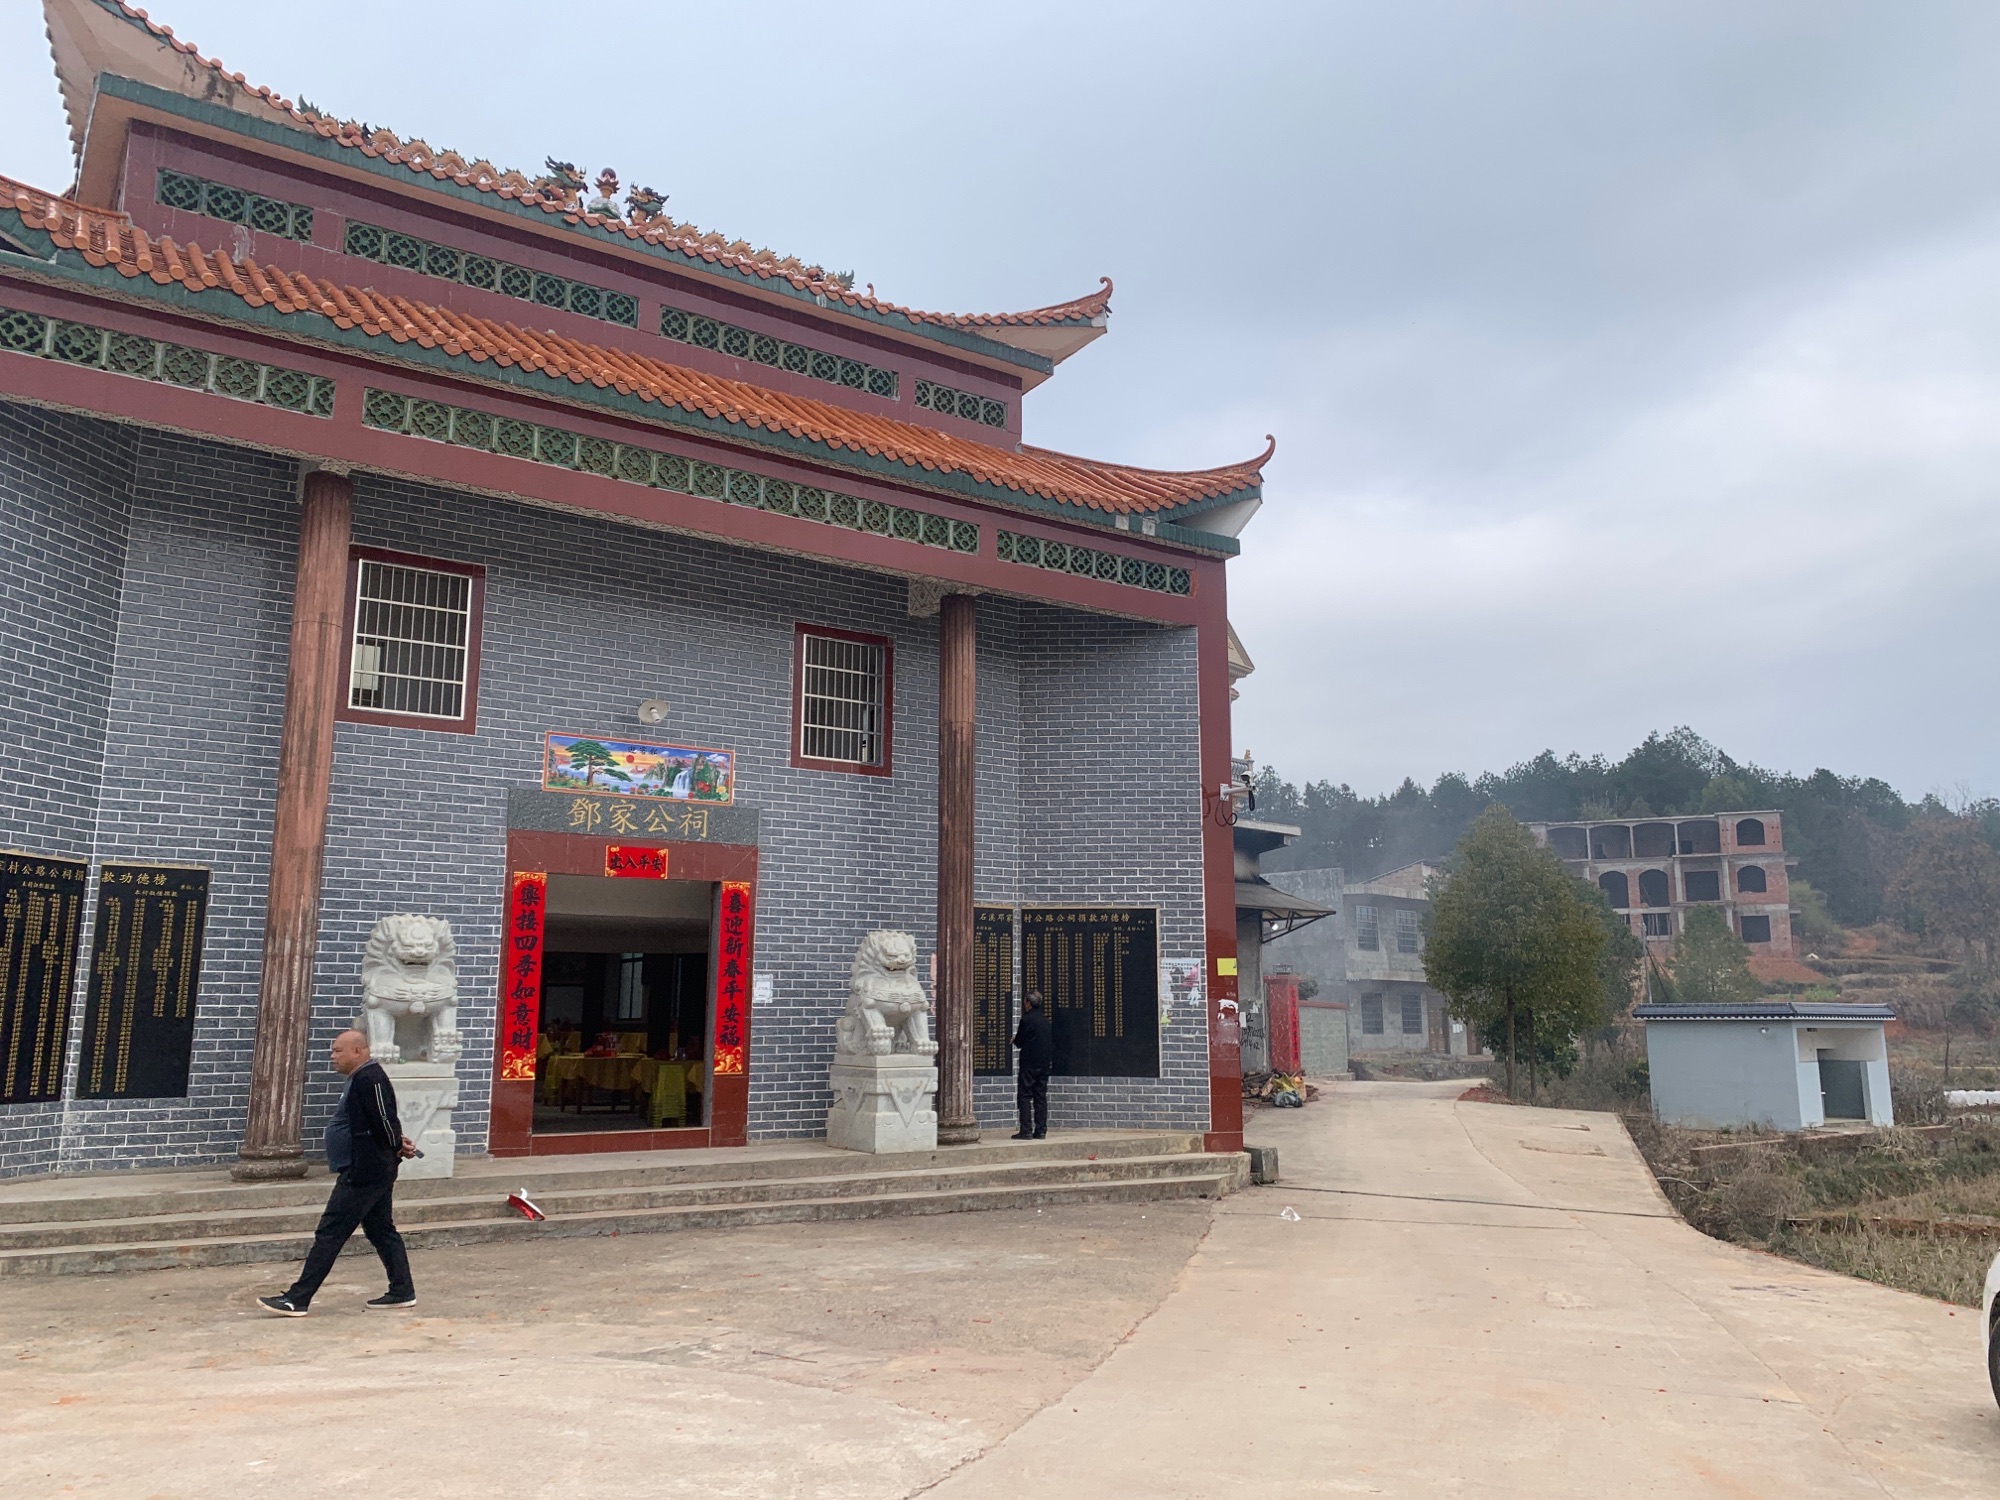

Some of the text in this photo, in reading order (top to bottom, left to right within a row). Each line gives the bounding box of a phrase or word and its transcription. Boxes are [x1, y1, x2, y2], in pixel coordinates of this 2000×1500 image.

[567, 798, 709, 838] 鄧家公祠
[609, 854, 663, 872] 出入平安
[101, 870, 168, 886] 款功德榜
[719, 892, 746, 1047] 喜迎新春平安福
